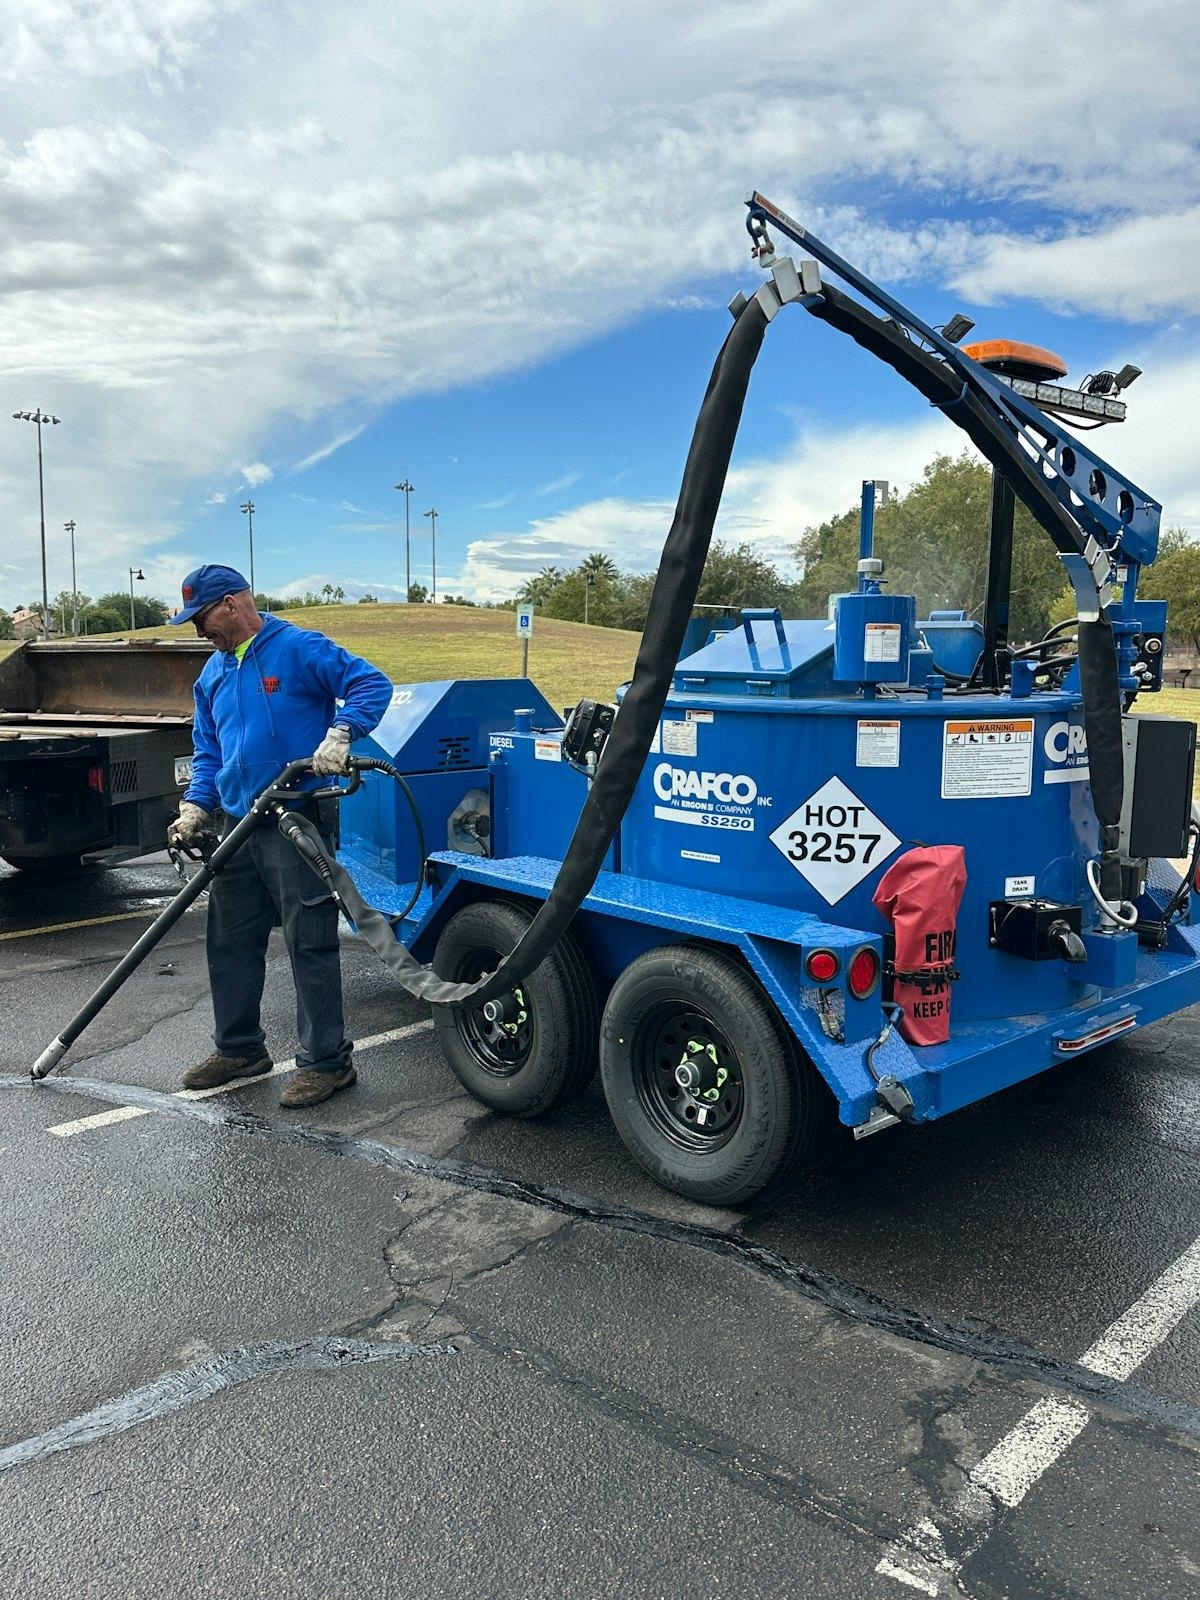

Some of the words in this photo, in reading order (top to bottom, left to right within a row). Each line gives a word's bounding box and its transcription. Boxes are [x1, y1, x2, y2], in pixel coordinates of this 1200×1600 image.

[977, 723, 1015, 732] WARNING
[489, 736, 515, 749] DIESEL
[653, 762, 758, 805] CRAFCO
[757, 796, 773, 807] INC
[671, 799, 680, 807] AN
[681, 800, 707, 811] ERGON
[715, 804, 753, 815] COMPANY
[700, 815, 751, 829] SS250
[805, 805, 865, 828] HOT
[787, 831, 881, 864] 3257
[913, 1001, 943, 1018] KEEP
